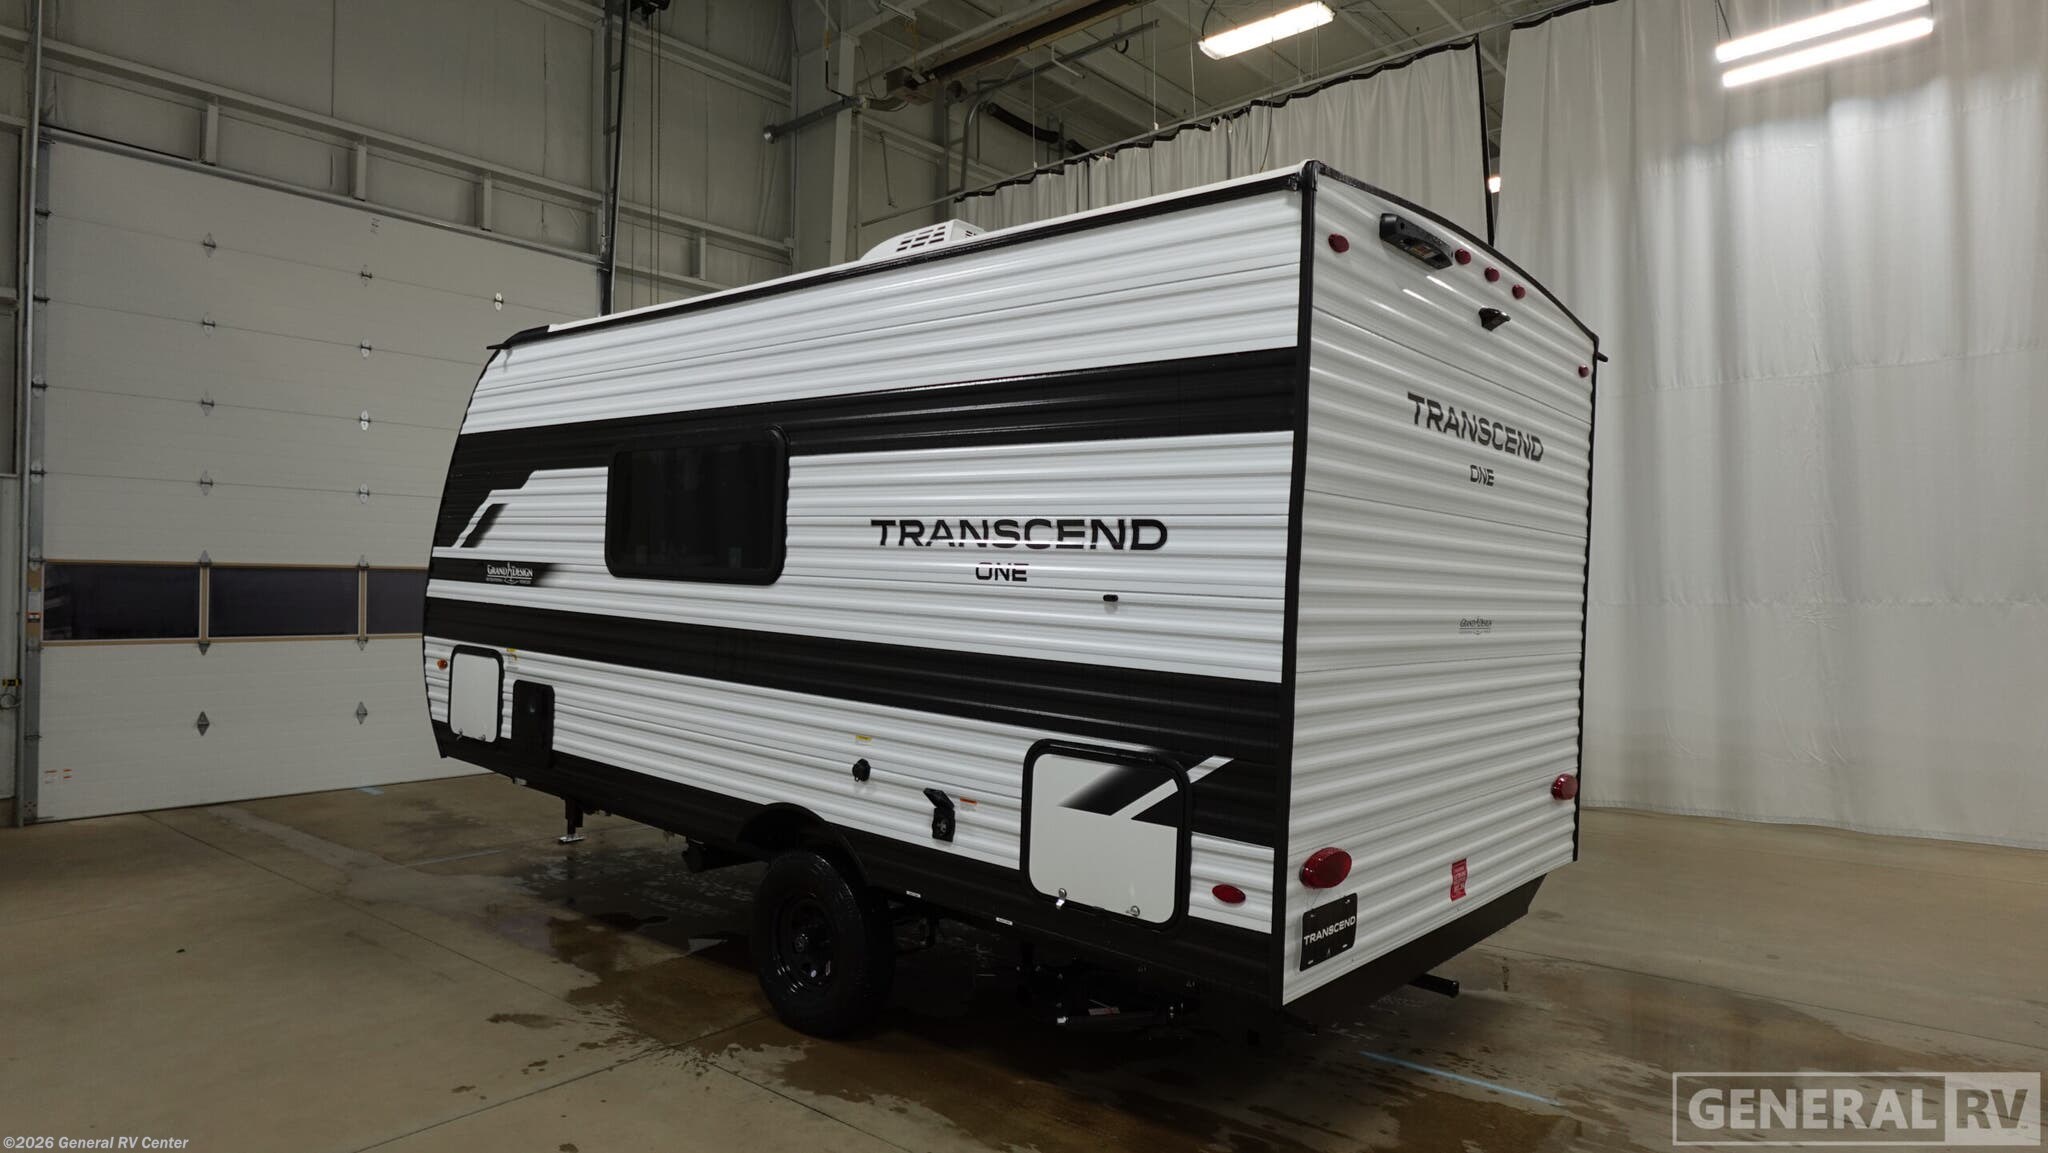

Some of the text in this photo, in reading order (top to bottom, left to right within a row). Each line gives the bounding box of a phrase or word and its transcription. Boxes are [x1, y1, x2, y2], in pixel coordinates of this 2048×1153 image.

[1407, 391, 1544, 462] TRANSCEND
[1470, 464, 1495, 487] ONE
[870, 518, 1168, 551] TRANSCEND
[975, 561, 1029, 582] ONE
[1303, 915, 1356, 946] TRANSCEND
